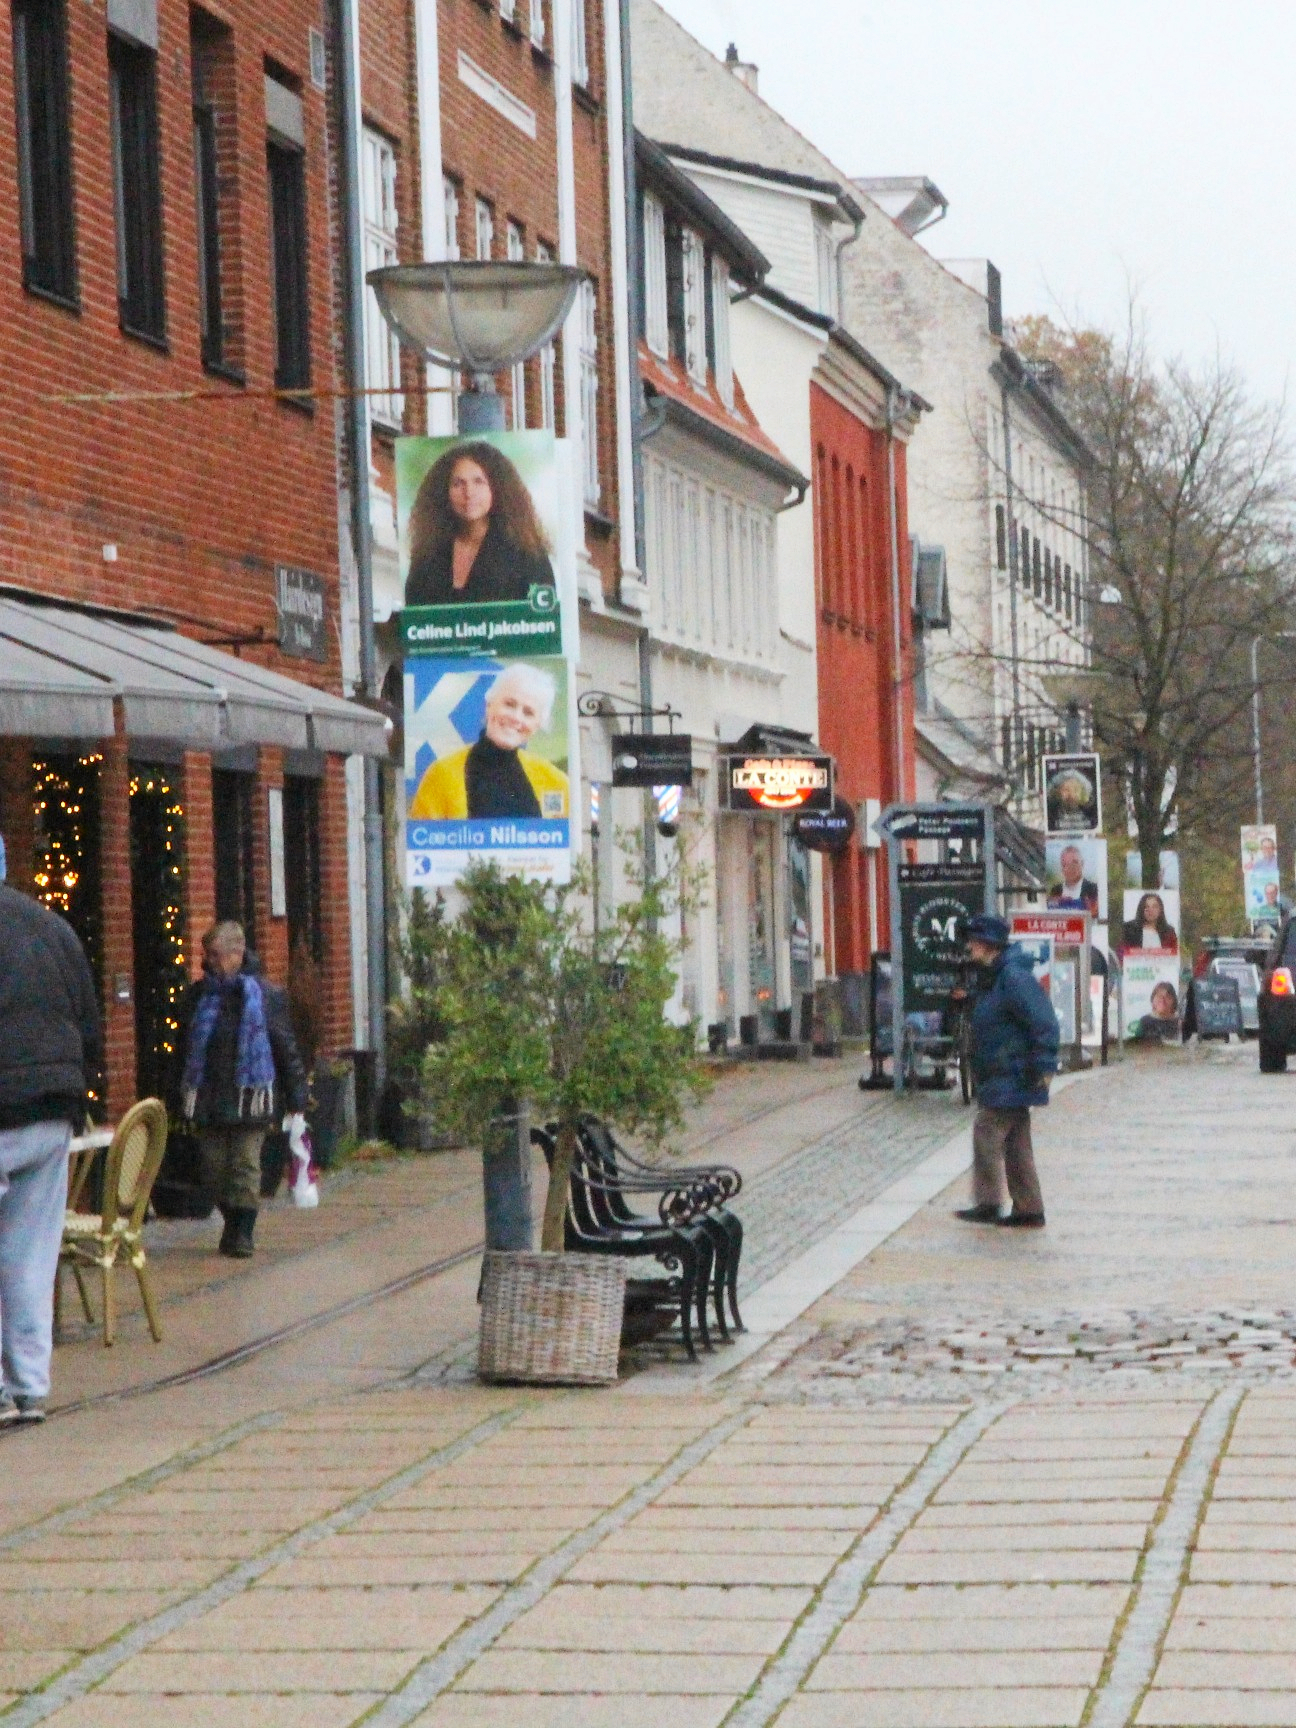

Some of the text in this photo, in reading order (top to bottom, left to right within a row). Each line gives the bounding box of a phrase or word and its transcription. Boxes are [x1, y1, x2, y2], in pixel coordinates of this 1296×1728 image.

[536, 590, 549, 607] C
[407, 620, 556, 640] Celine Lind Jakobsen
[738, 770, 824, 786] LA CONTE
[412, 824, 563, 846] Cæcilia Nilsson
